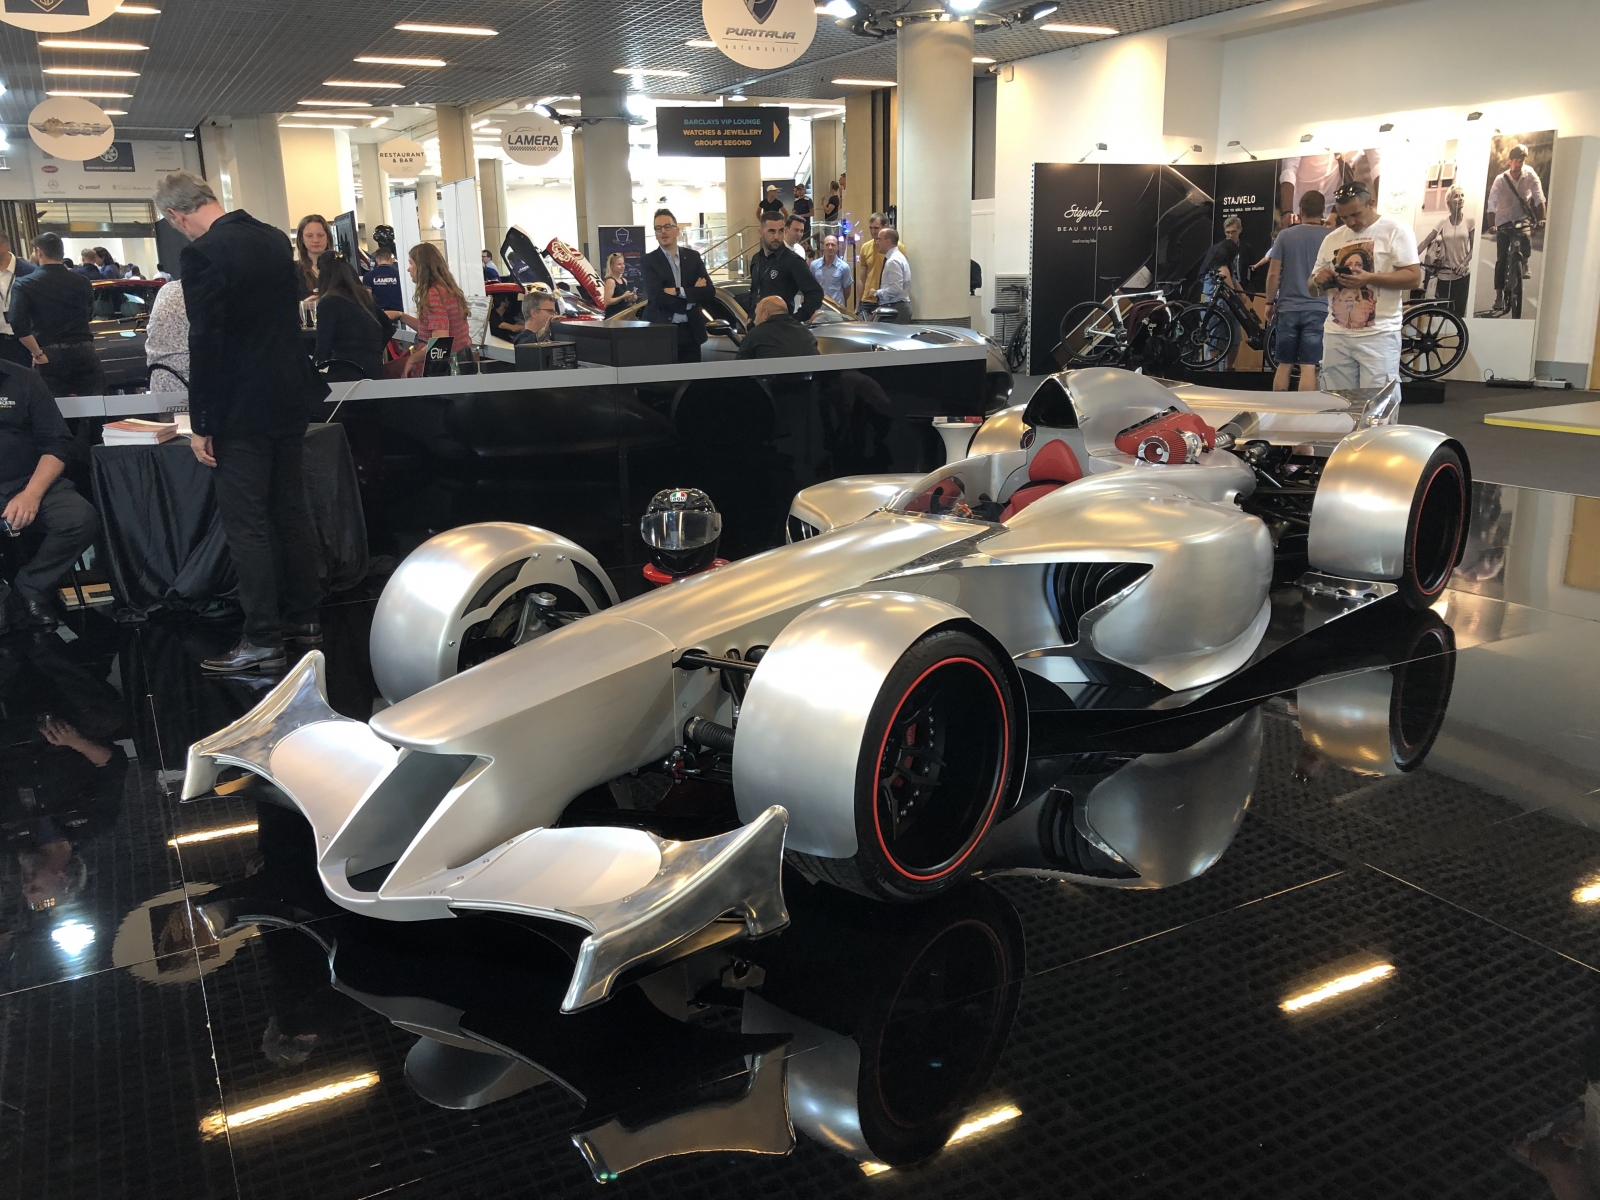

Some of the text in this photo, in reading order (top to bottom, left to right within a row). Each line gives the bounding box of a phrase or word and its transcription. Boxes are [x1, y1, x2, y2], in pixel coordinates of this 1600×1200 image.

[726, 27, 796, 40] PURITALIA
[507, 134, 559, 146] LAMERA
[694, 139, 722, 147] GROUPE
[1223, 195, 1256, 205] STAJVELO
[1063, 201, 1109, 223] Stajvelo
